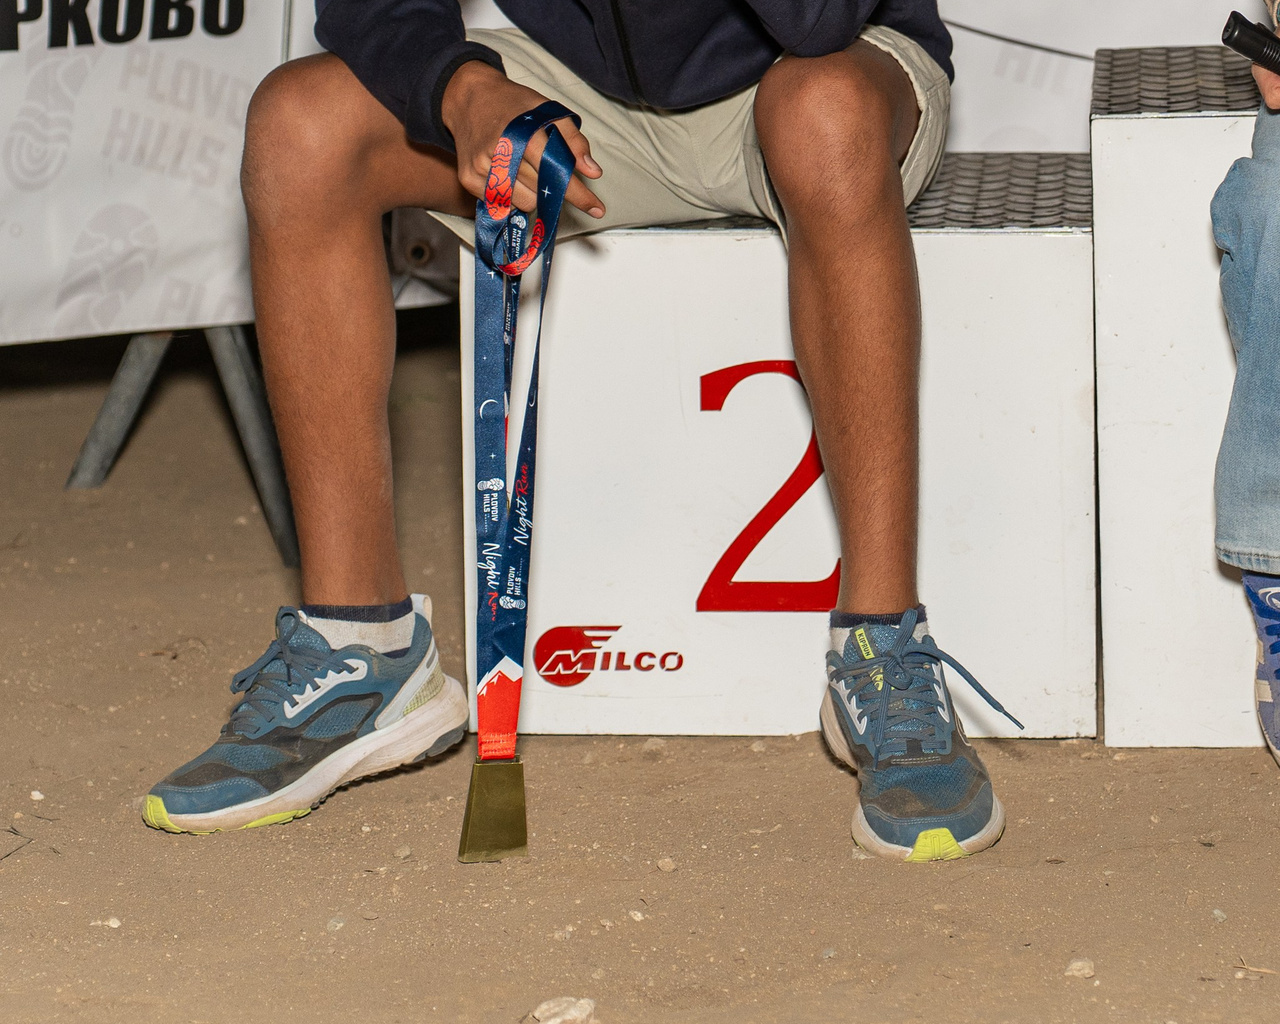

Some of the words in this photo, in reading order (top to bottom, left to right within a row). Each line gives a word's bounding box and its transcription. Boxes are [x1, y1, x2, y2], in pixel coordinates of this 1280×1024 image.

[696, 360, 842, 612] 2
[483, 493, 491, 513] HILLS
[490, 492, 499, 522] PLOVDIV
[506, 565, 516, 595] PLOVDIV
[541, 647, 684, 675] MILCO
